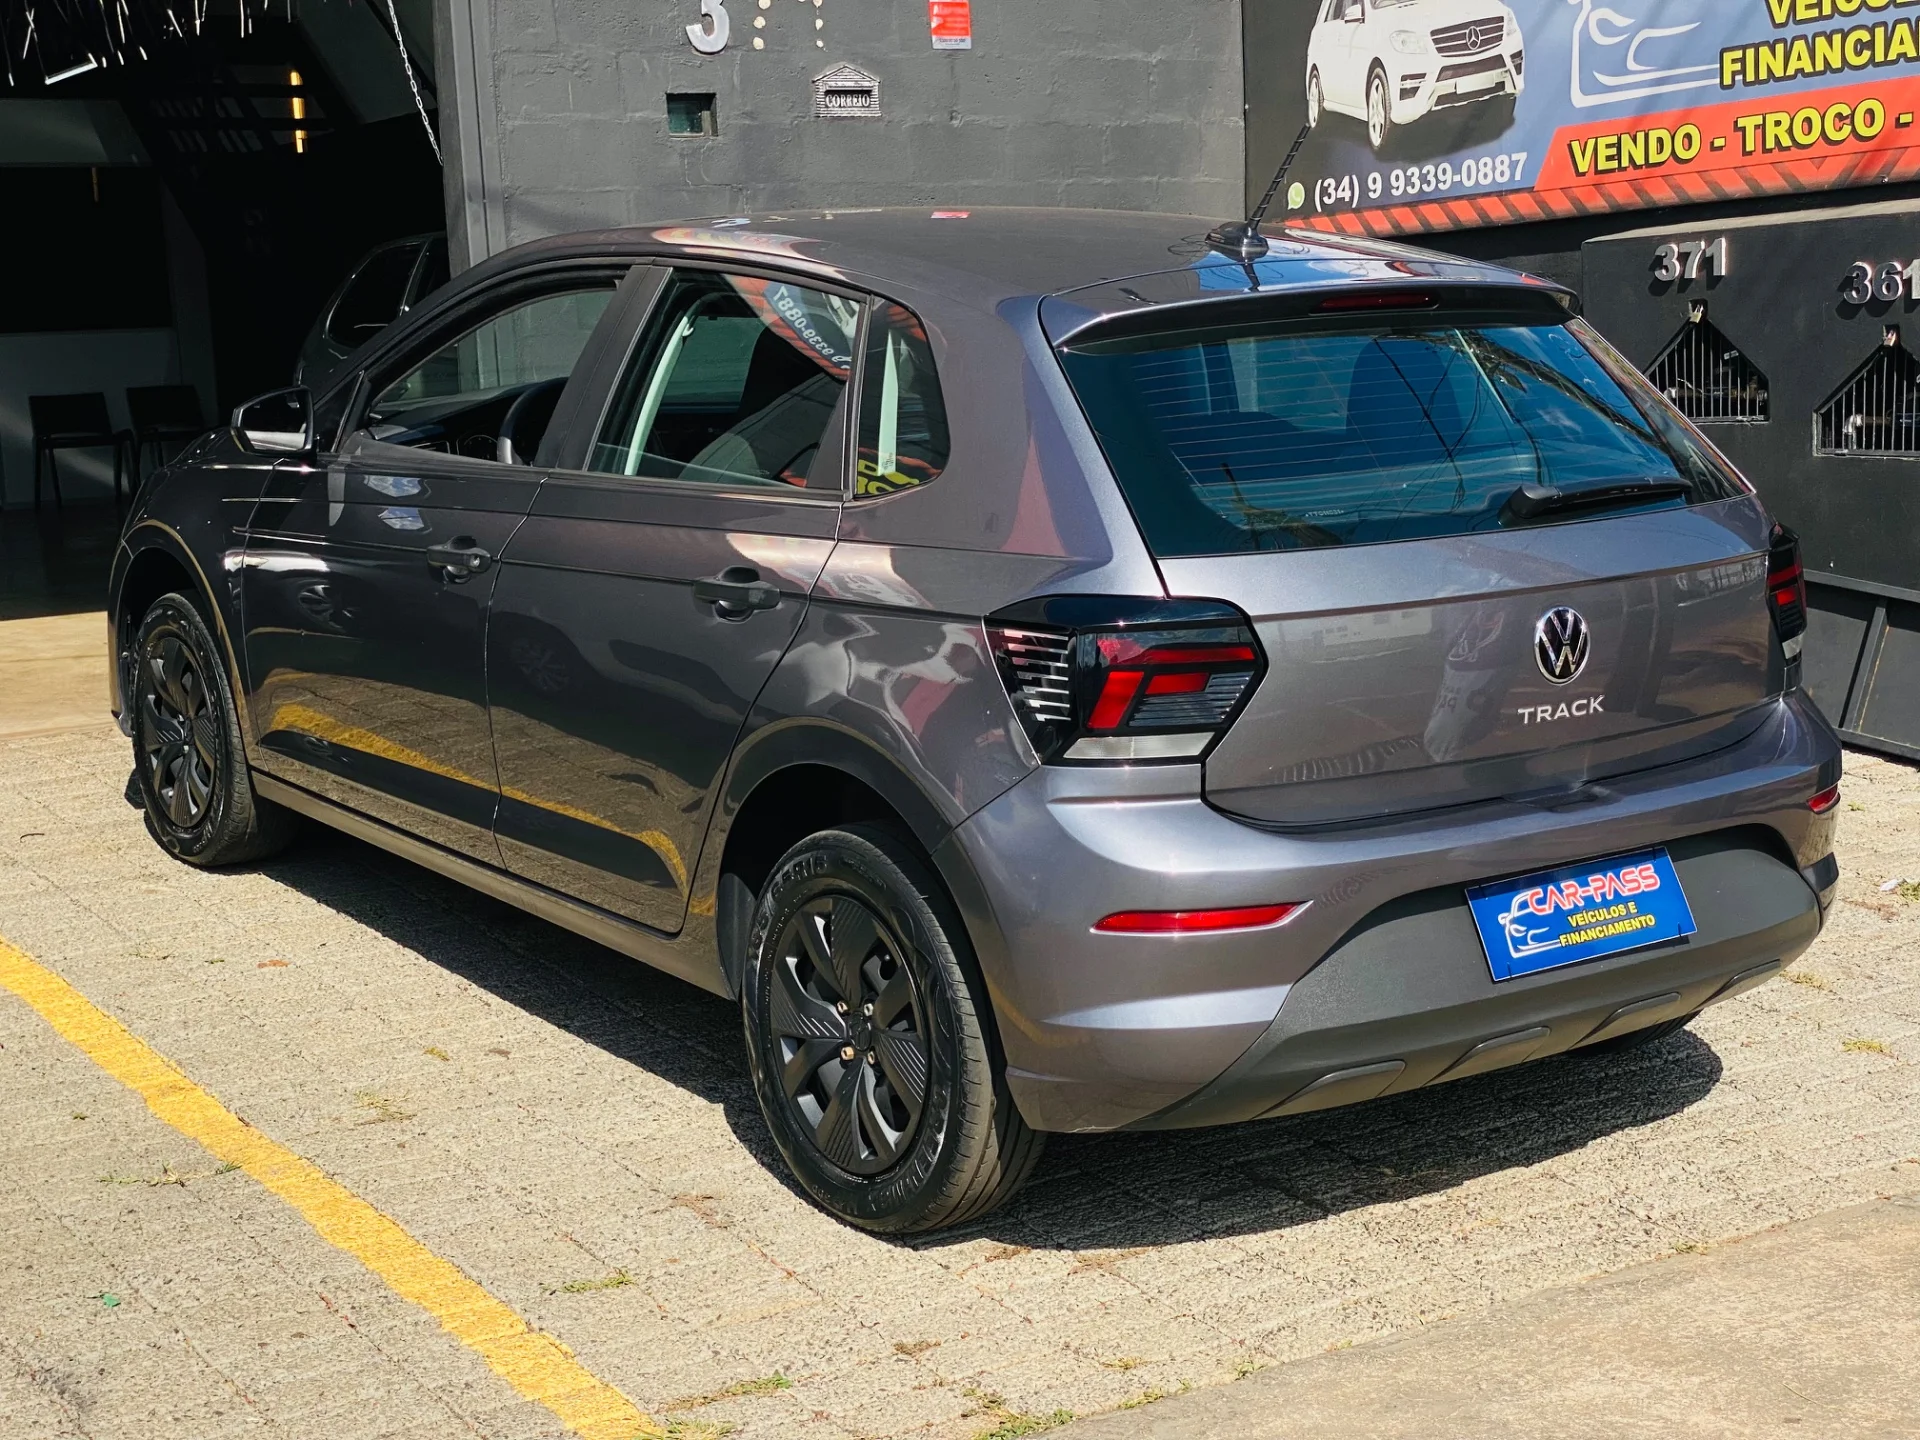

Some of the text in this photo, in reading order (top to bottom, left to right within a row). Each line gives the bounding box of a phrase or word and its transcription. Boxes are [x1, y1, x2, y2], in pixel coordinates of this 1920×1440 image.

[1721, 22, 1920, 87] FINANCIA
[825, 94, 871, 108] CORREIO
[1570, 123, 1702, 174] VENDO
[1736, 98, 1885, 152] TROCO
[1314, 152, 1527, 212] (34) 9 9339-0887
[1653, 237, 1726, 282] 371
[1843, 259, 1920, 304] 361
[1518, 695, 1604, 724] TRACK
[1527, 864, 1661, 915] CAR-PASS
[1559, 914, 1656, 948] FINANCIAMENTO
[1567, 901, 1638, 928] VEÍCULOS E
